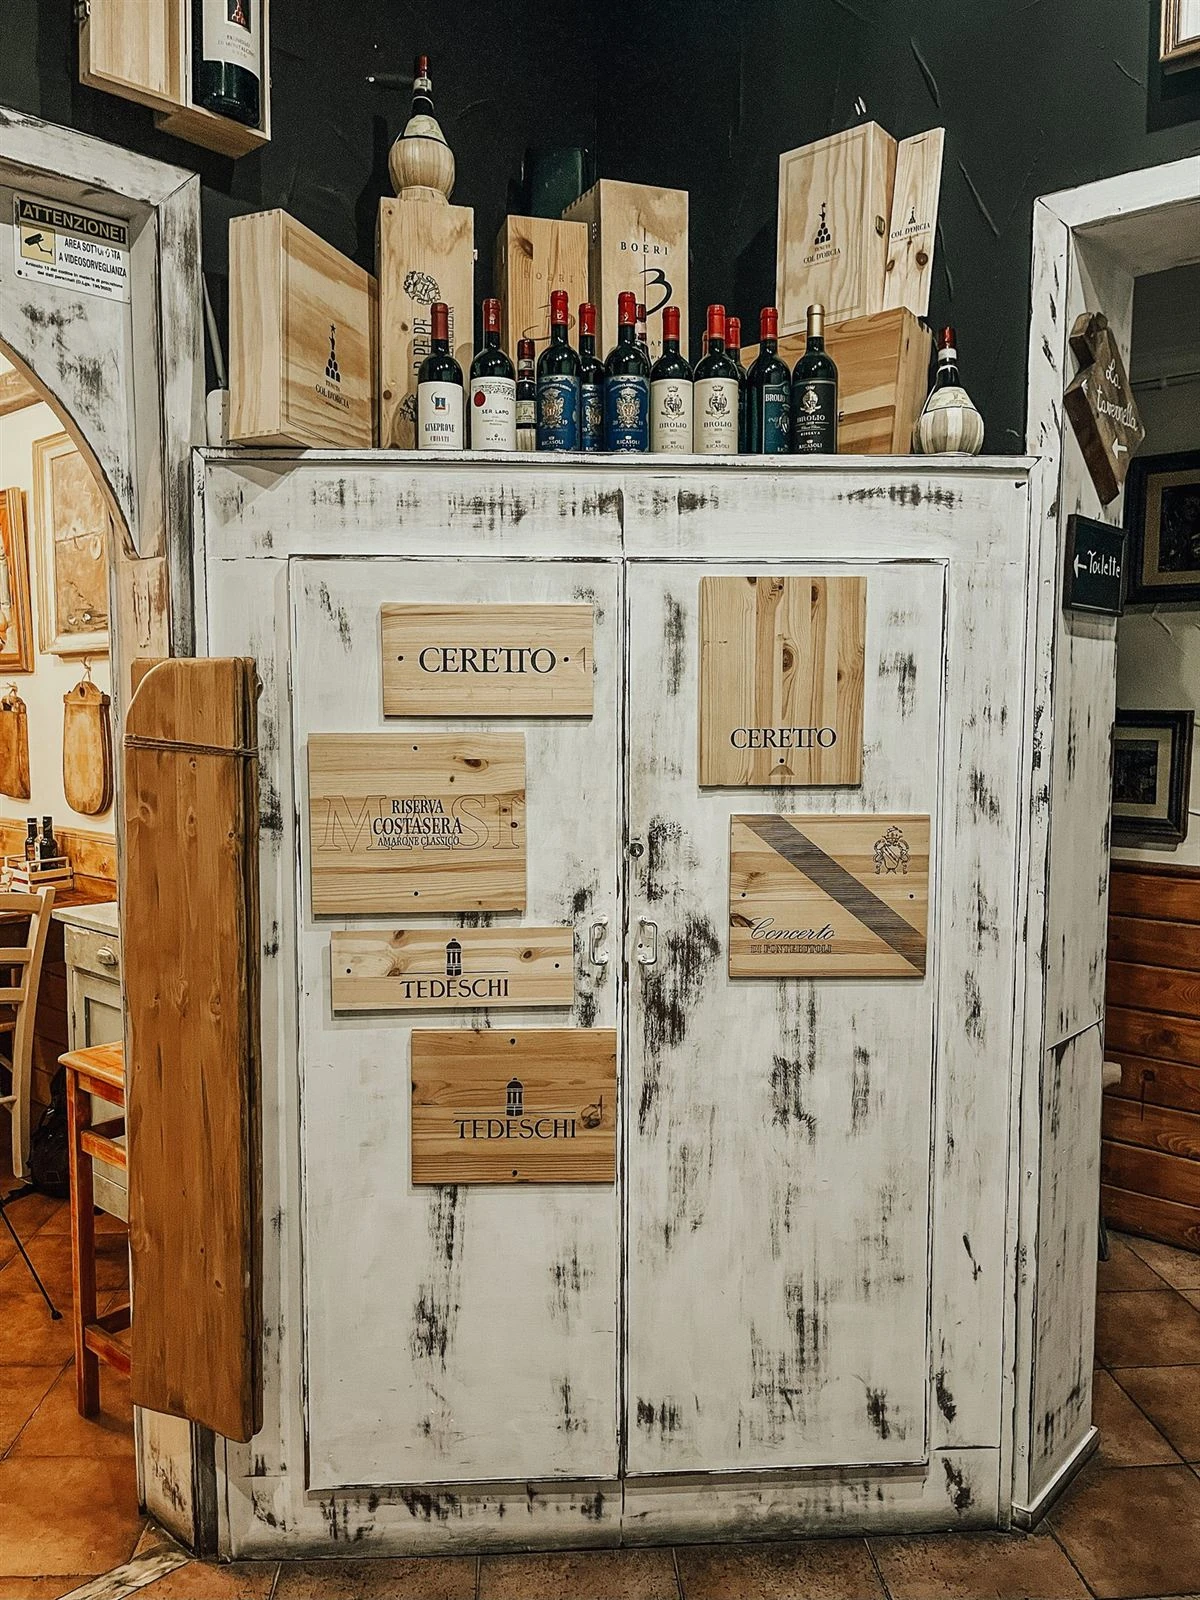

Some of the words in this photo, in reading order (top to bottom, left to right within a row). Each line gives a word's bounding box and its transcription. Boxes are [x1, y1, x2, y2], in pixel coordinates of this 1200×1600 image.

[23, 203, 125, 242] ATTENZIONE!
[891, 231, 903, 239] COL
[904, 222, 931, 235] D'ORCIA
[64, 238, 81, 251] AREA
[620, 242, 669, 255] BOERI
[58, 252, 63, 261] A
[64, 252, 127, 278] VIDEOSORVEGLIANZA
[803, 256, 815, 265] COL
[315, 384, 327, 398] COL
[765, 393, 786, 402] BROLIO
[659, 421, 687, 429] BROLIO
[796, 414, 826, 423] BROLIO
[425, 423, 455, 433] GINEPRONE
[1087, 550, 1121, 578] Toilette
[418, 647, 557, 673] CERETTO
[730, 727, 837, 749] CERETTO
[391, 799, 444, 814] RISERVA
[373, 817, 463, 836] COSTASERA
[377, 836, 420, 846] AMARONE
[420, 836, 460, 846] CLASSICO
[750, 917, 835, 940] Concerto
[399, 978, 509, 999] TEDESCHI
[453, 1118, 576, 1139] TEDESCHI
